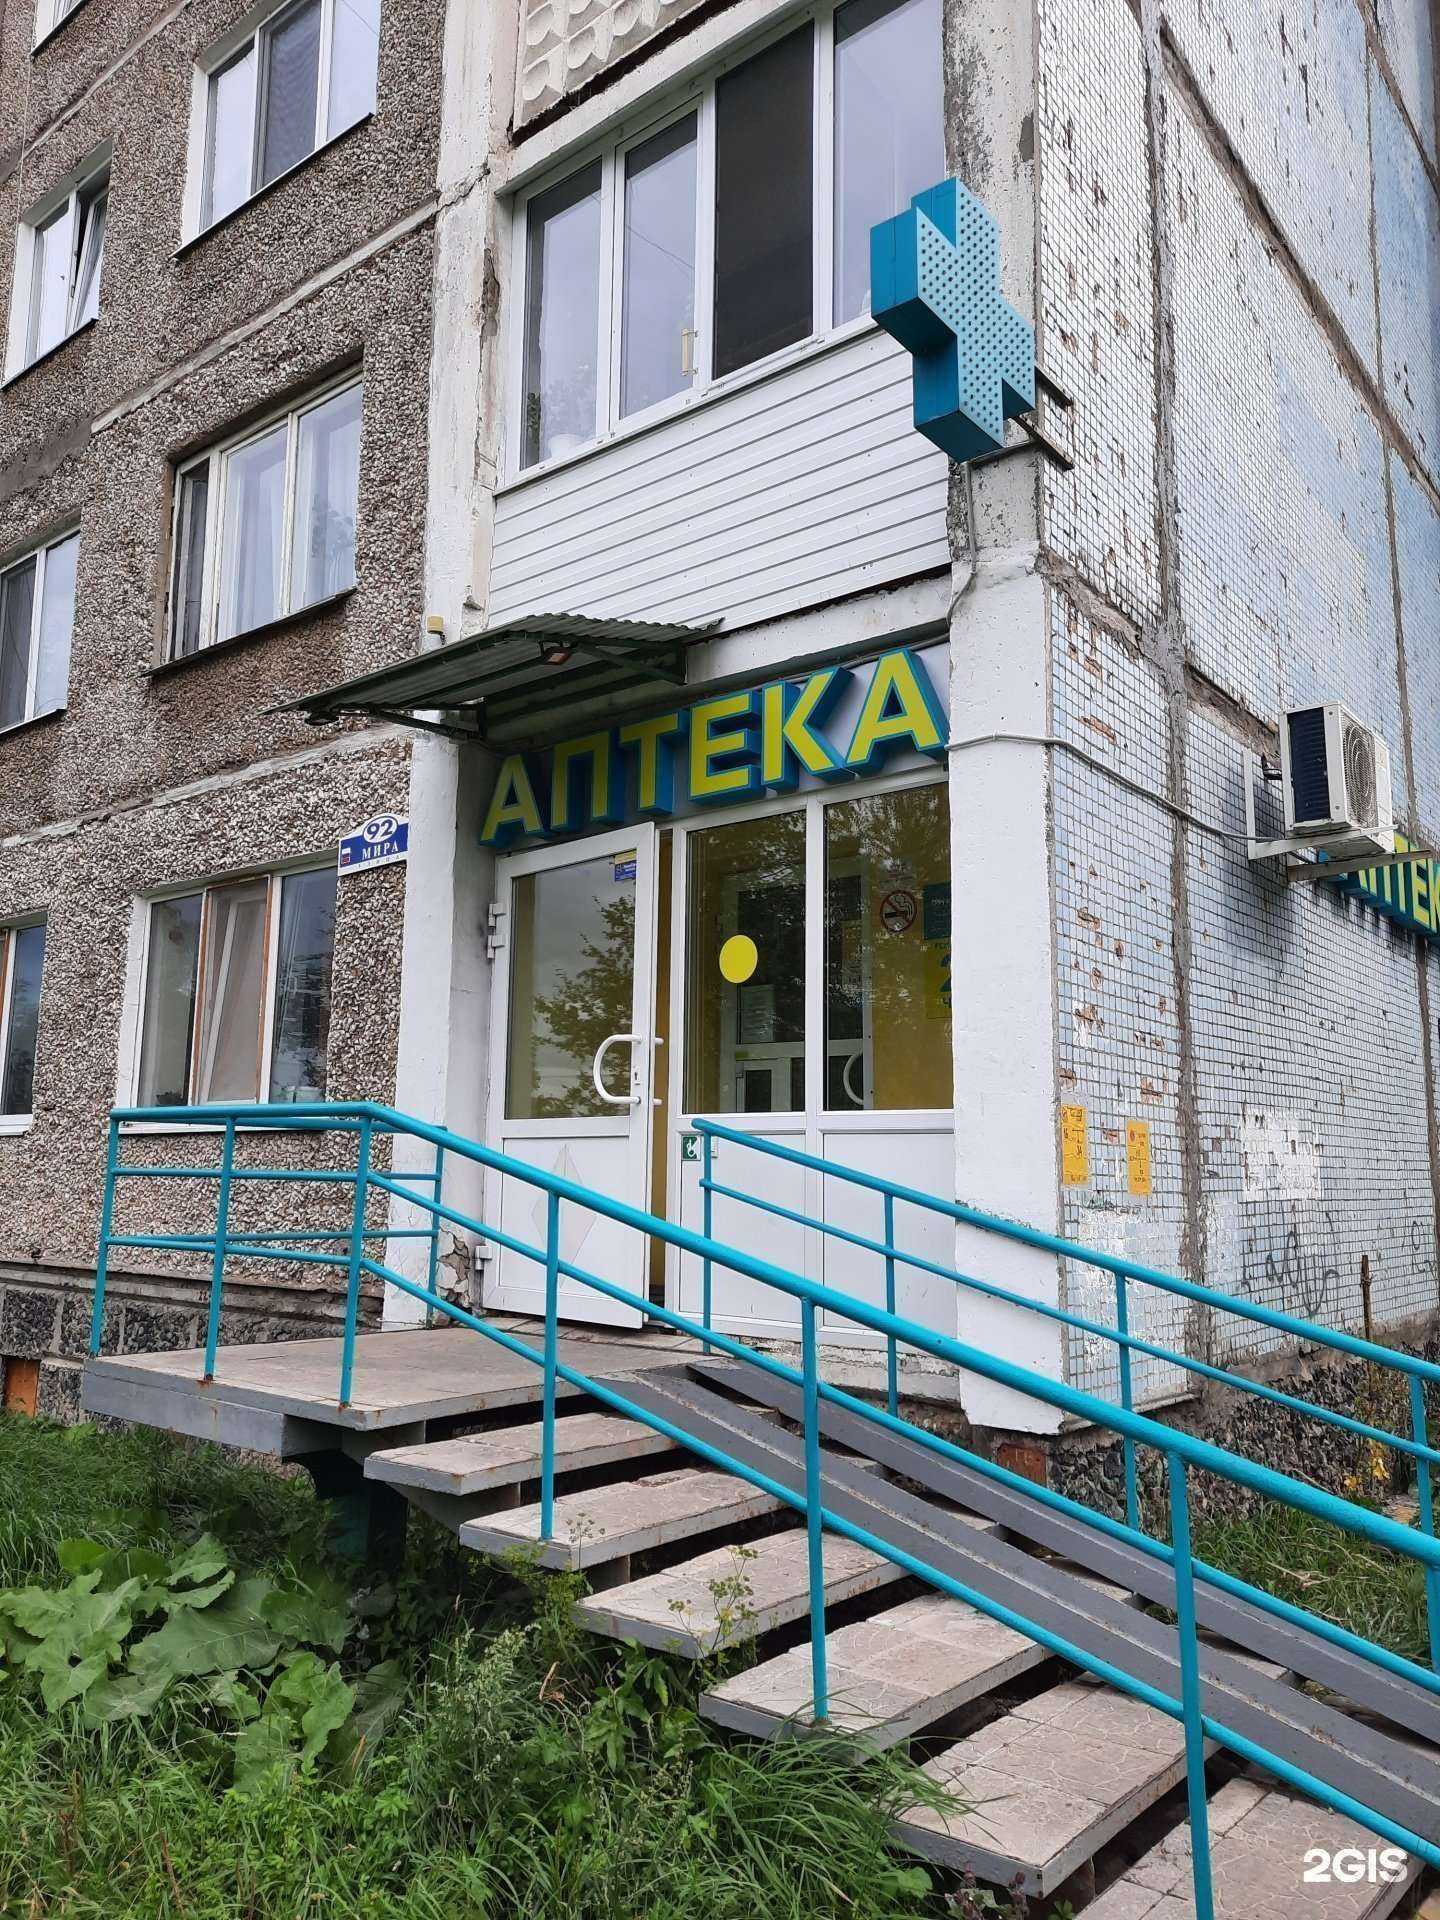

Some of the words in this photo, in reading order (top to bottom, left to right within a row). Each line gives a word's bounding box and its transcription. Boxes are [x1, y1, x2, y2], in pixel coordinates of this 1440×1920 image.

[479, 647, 947, 848] АПТЕКА
[366, 819, 394, 841] 92
[362, 839, 399, 861] МИРА
